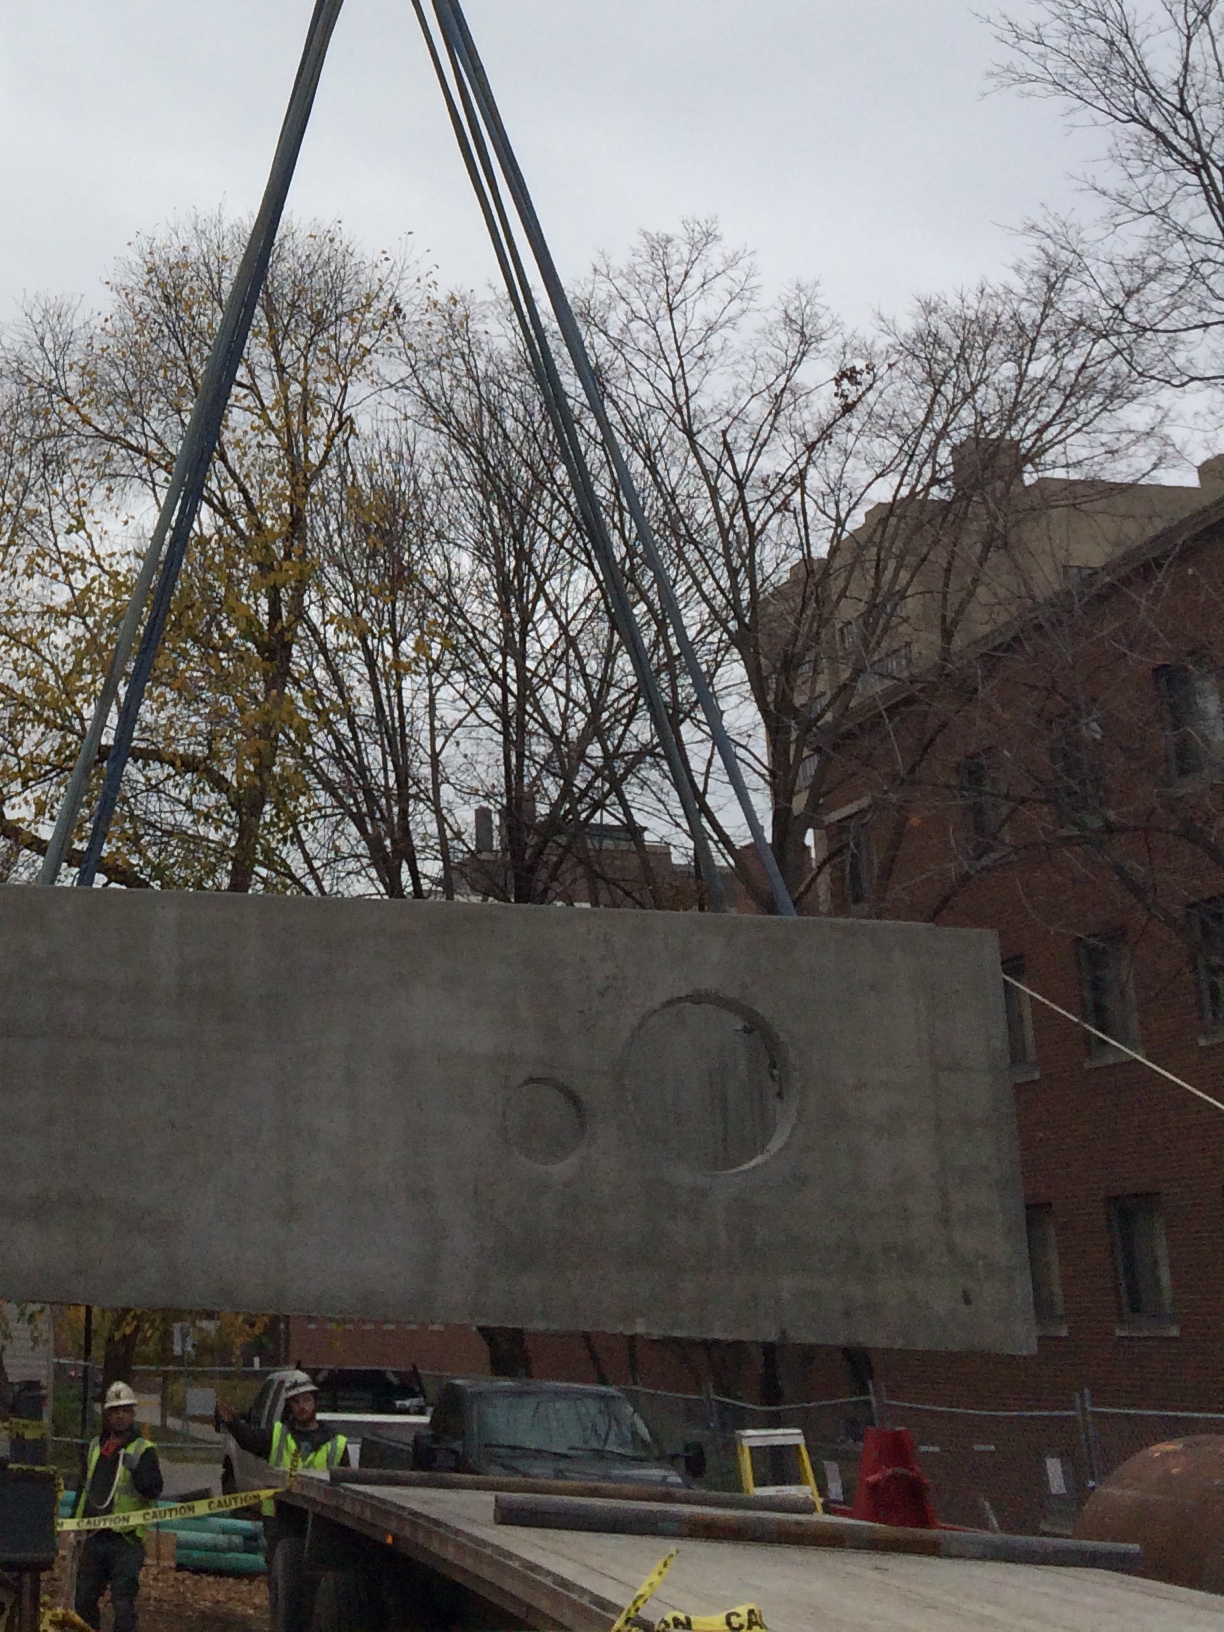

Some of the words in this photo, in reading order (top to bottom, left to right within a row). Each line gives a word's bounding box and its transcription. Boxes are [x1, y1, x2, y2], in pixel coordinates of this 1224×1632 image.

[76, 1514, 131, 1529] CAUTION
[142, 1505, 196, 1522] CAUTION
[208, 1492, 261, 1510] CAUTION
